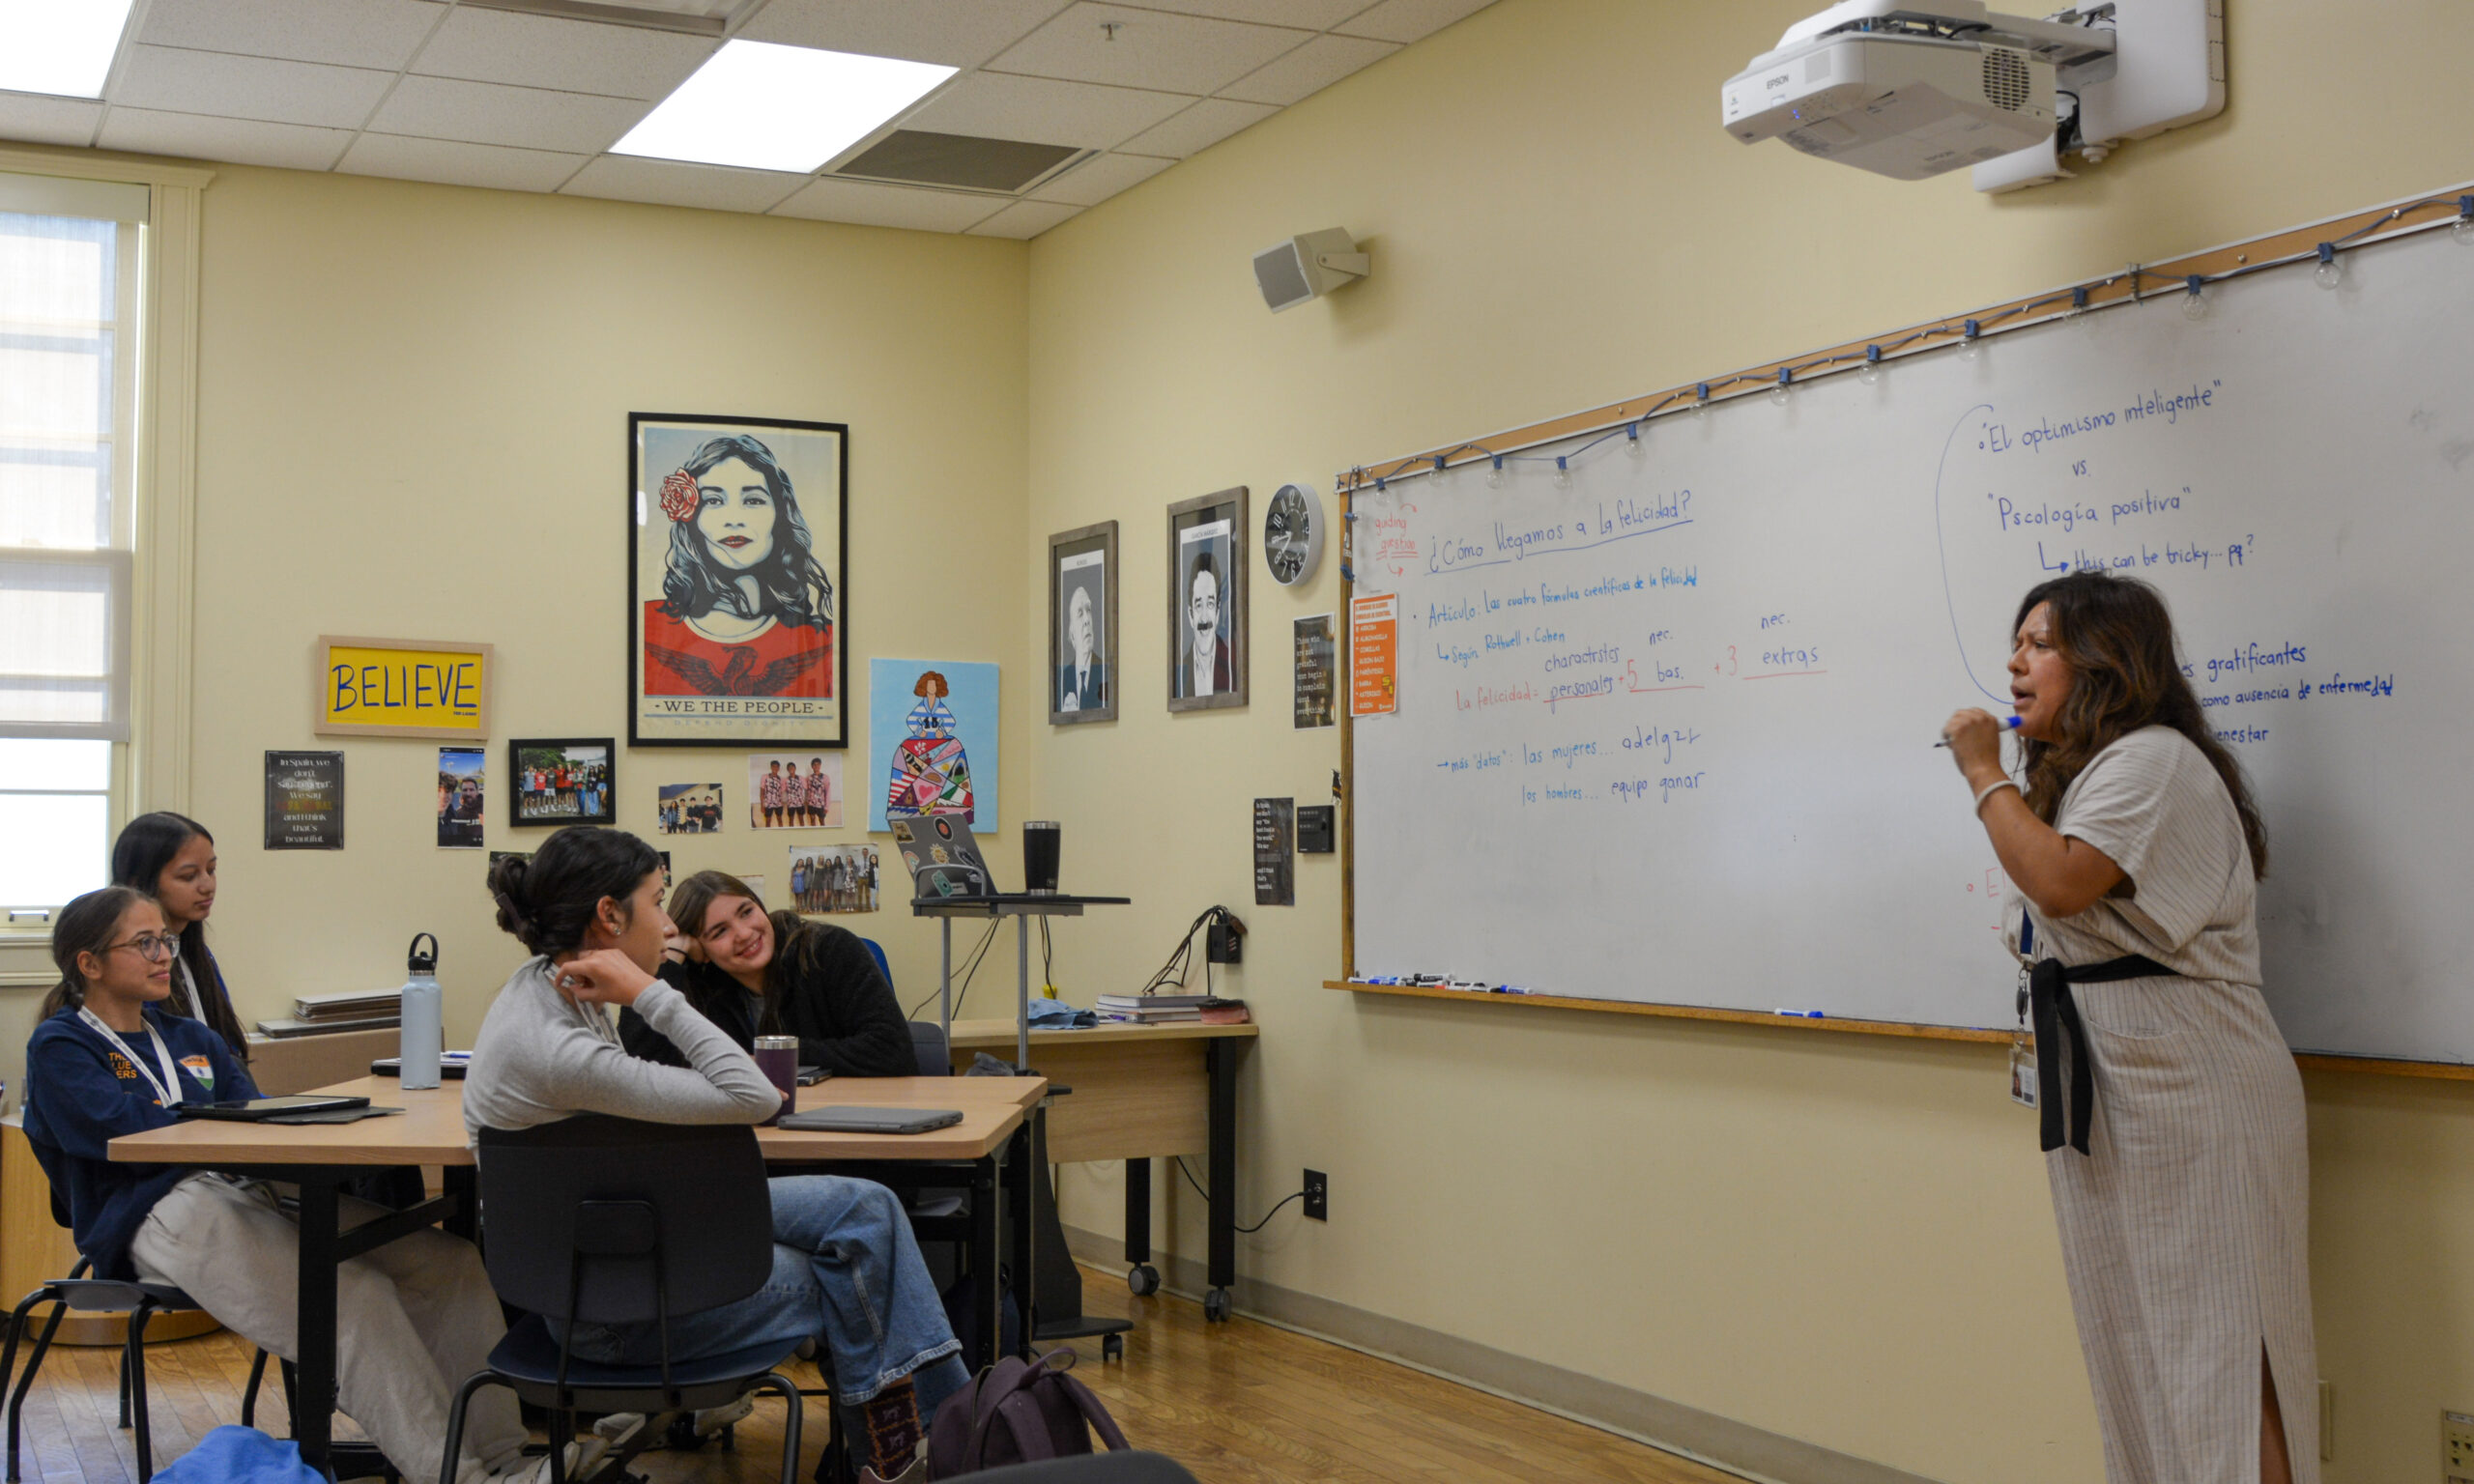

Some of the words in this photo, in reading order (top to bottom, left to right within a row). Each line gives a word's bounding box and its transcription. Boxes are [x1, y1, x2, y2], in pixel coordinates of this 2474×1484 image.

[1766, 74, 1789, 90] EPSON
[2022, 416, 2116, 454] optimismo
[1430, 535, 1483, 573] ¿Cómo
[1494, 522, 1564, 560] llegamos
[1576, 523, 1587, 536] a
[1617, 489, 1691, 528] felicidad?
[2075, 549, 2105, 572] this
[2113, 556, 2136, 570] can
[2142, 543, 2159, 566] be
[1508, 587, 1537, 608] cuatro
[1535, 627, 1566, 643] Cohen
[2207, 642, 2307, 682] gratificantes
[332, 663, 478, 712] BELIEVE
[1550, 674, 1613, 715] personales
[1763, 646, 1818, 669] extras
[2201, 692, 2230, 708] como
[2235, 683, 2290, 704] ausencia
[2297, 678, 2312, 700] de
[664, 700, 695, 712] WE
[701, 700, 738, 713] THE
[745, 701, 815, 714] PEOPLE
[1611, 780, 1648, 804] equipo
[1659, 772, 1706, 804] ganar
[116, 1070, 137, 1079] ERS
